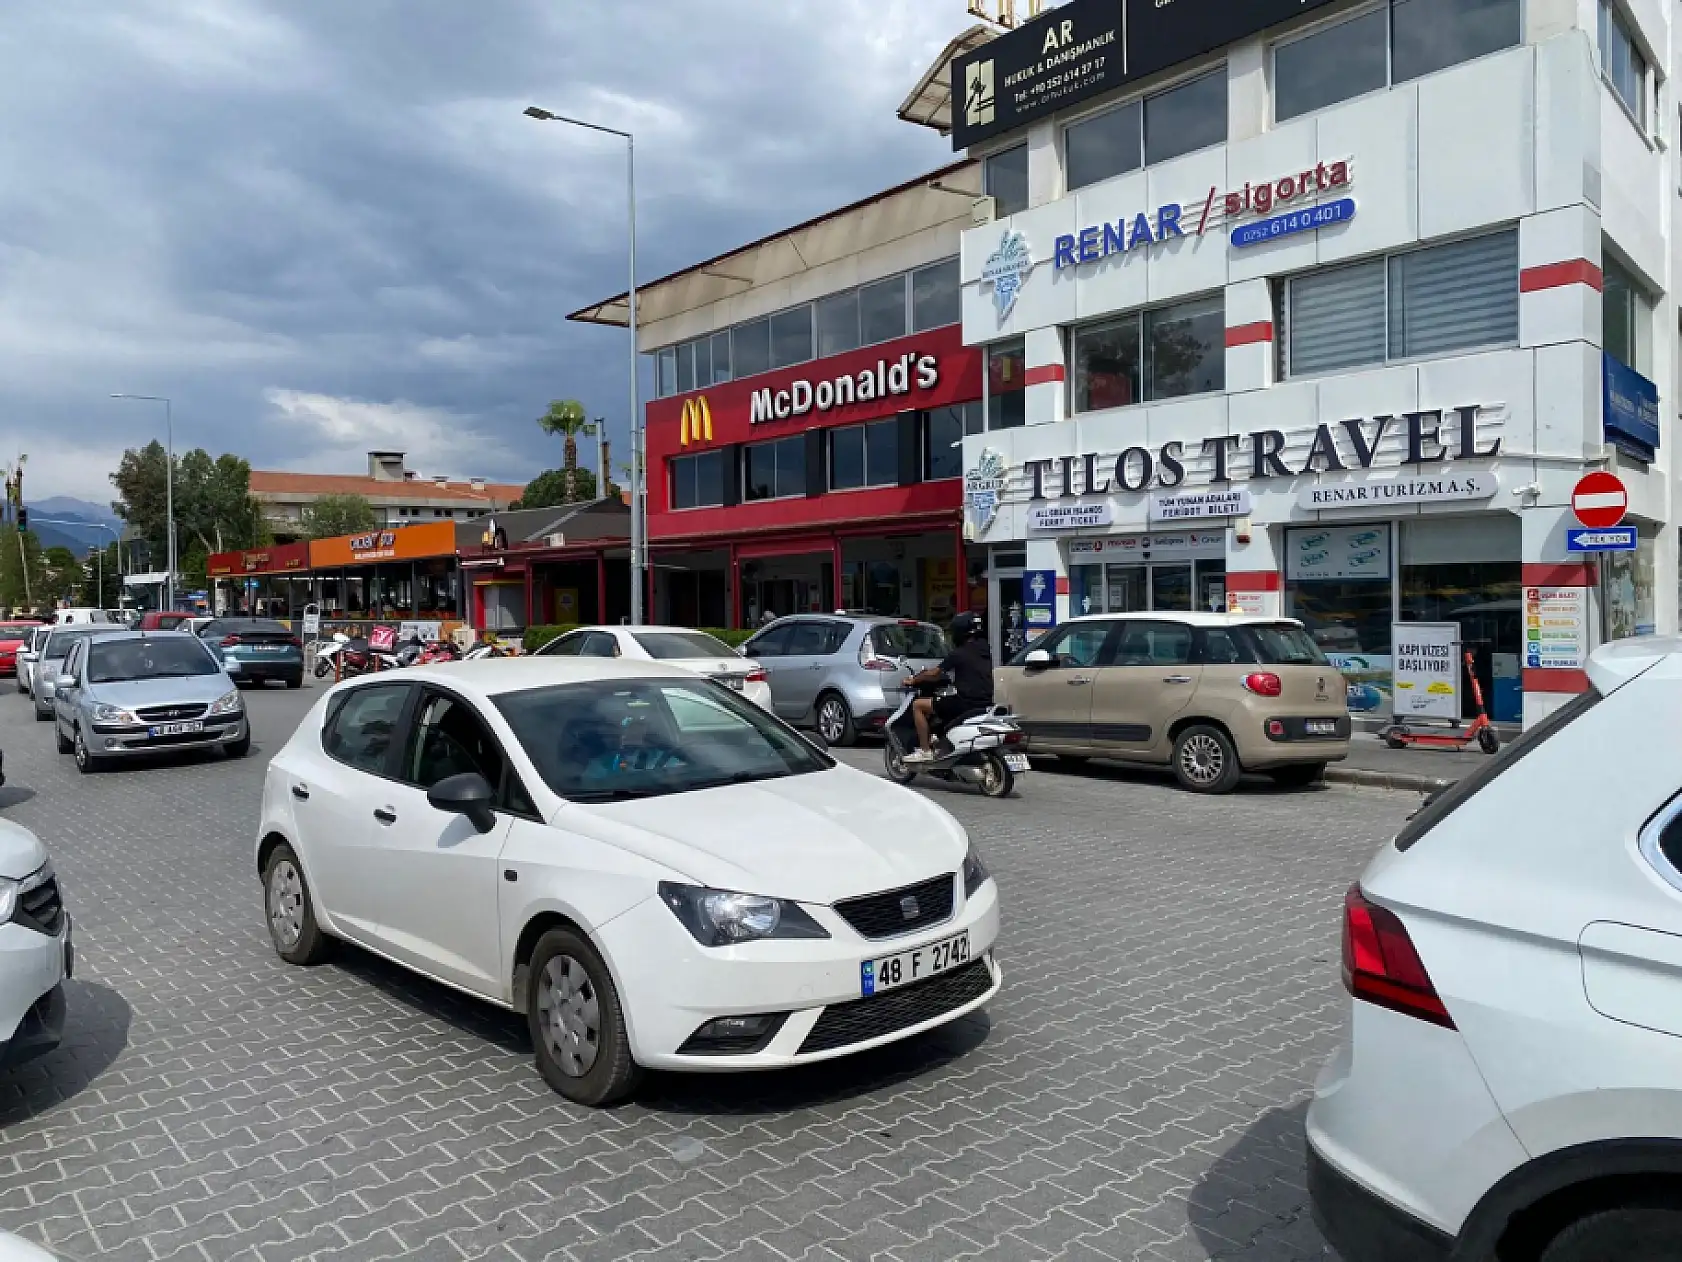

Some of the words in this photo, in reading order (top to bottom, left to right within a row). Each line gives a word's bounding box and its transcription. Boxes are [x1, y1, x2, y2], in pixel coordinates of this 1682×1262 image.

[1042, 20, 1074, 54] AR
[1004, 65, 1035, 88] HUKUK
[1055, 202, 1184, 270] RENAR
[1224, 161, 1349, 214] sigorta
[1243, 227, 1269, 242] 0252
[1271, 216, 1298, 234] 614
[1300, 212, 1311, 227] 0
[1314, 203, 1341, 222] 401
[750, 352, 938, 424] McDonald's
[1024, 440, 1188, 500] TILOS
[1202, 404, 1501, 483] TRAVEL
[1312, 485, 1368, 503] RENAR
[1371, 479, 1443, 499] TURİZM
[1446, 477, 1481, 495] A.Ş.
[1398, 643, 1420, 656] KAPI
[1420, 643, 1449, 657] VİZESİ
[879, 957, 901, 985] 48
[912, 952, 922, 978] F
[932, 936, 967, 971] 2742
